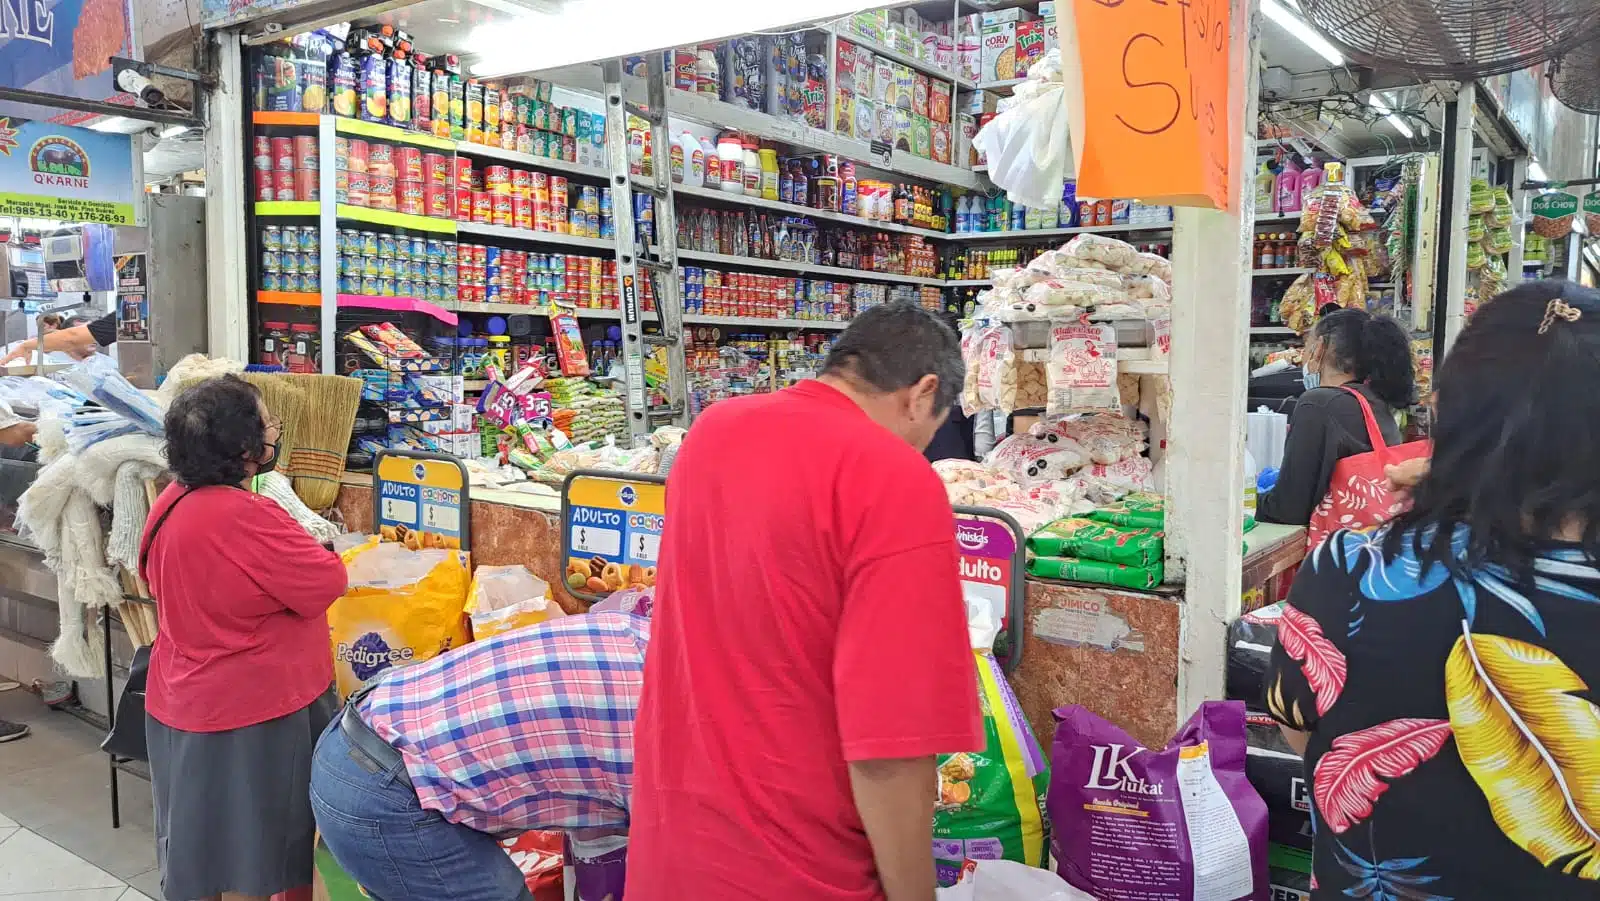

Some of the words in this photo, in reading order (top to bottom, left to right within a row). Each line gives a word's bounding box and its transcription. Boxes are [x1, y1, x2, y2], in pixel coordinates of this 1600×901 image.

[985, 35, 1010, 46] CORN
[1017, 29, 1043, 50] Trix
[803, 86, 825, 107] Trix
[1533, 202, 1550, 210] DOG
[1551, 201, 1577, 209] CHOW
[71, 212, 76, 220] y
[80, 211, 126, 224] 176-26-93
[626, 286, 635, 321] CUPRUM
[382, 481, 416, 498] ADULTO
[387, 499, 392, 514] $
[428, 505, 434, 521] $
[572, 506, 621, 526] ADULTO
[628, 513, 665, 532] cacho
[580, 527, 586, 545] $
[639, 534, 645, 553] $
[336, 642, 414, 669] Pedigree
